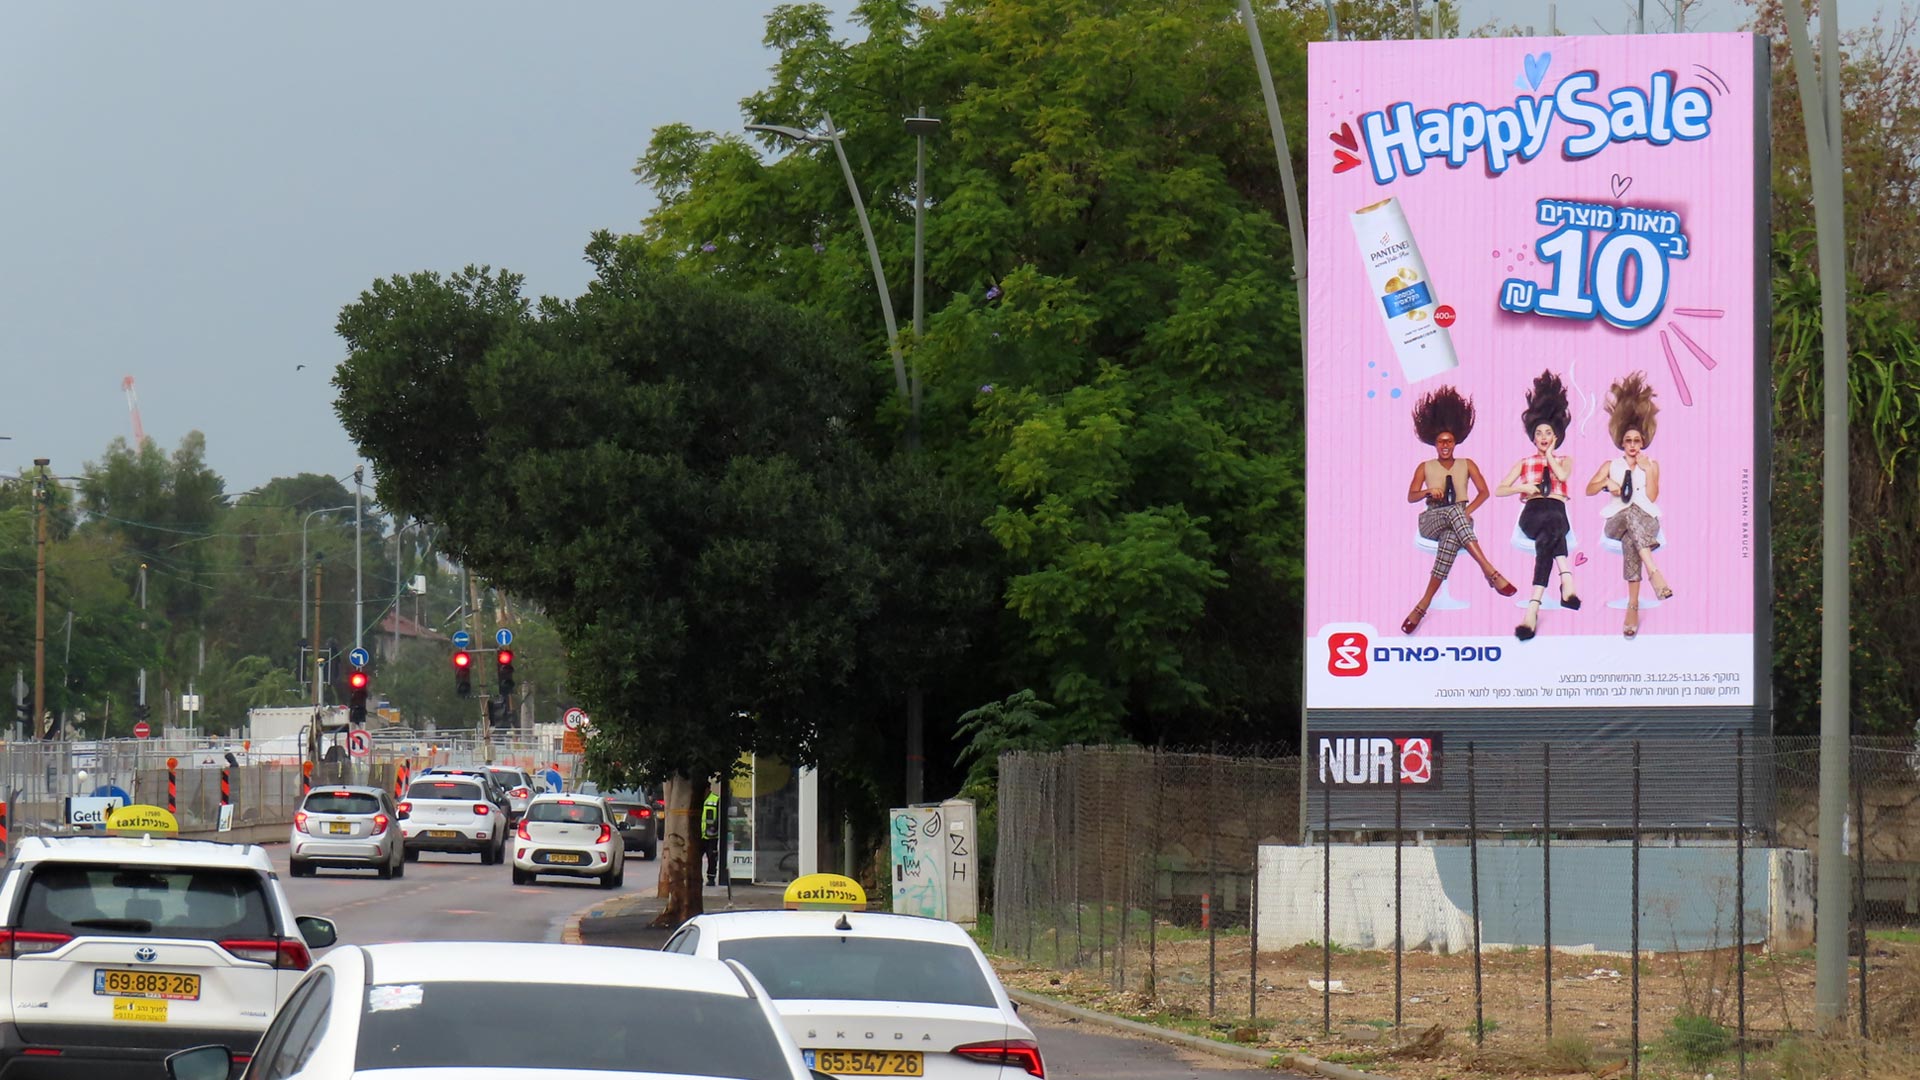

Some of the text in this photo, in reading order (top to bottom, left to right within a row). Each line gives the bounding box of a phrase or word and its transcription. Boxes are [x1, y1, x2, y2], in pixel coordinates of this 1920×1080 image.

[1365, 73, 1711, 182] Happy Sale
[1540, 203, 1676, 235] מאות מוצרים
[1370, 240, 1410, 262] PANTENE
[1373, 646, 1502, 662] סופר-פארם
[1590, 673, 1642, 683] מהמשתתפים
[1712, 672, 1740, 683] בתוקף:
[1468, 687, 1490, 697] לתנאי
[1493, 688, 1511, 699] כפוף
[1541, 686, 1553, 696] של
[1556, 687, 1580, 698] הקודם
[1583, 687, 1609, 696] המחיר
[1611, 686, 1627, 696] לגבי
[1629, 687, 1654, 696] הרשת
[1656, 686, 1679, 695] חנויות
[1681, 686, 1691, 697] בין
[1718, 686, 1740, 697] תיתכן
[1318, 738, 1394, 784] NUR
[73, 810, 102, 822] Gett
[116, 816, 170, 829] taxi מונית
[797, 886, 857, 901] taxi מונית
